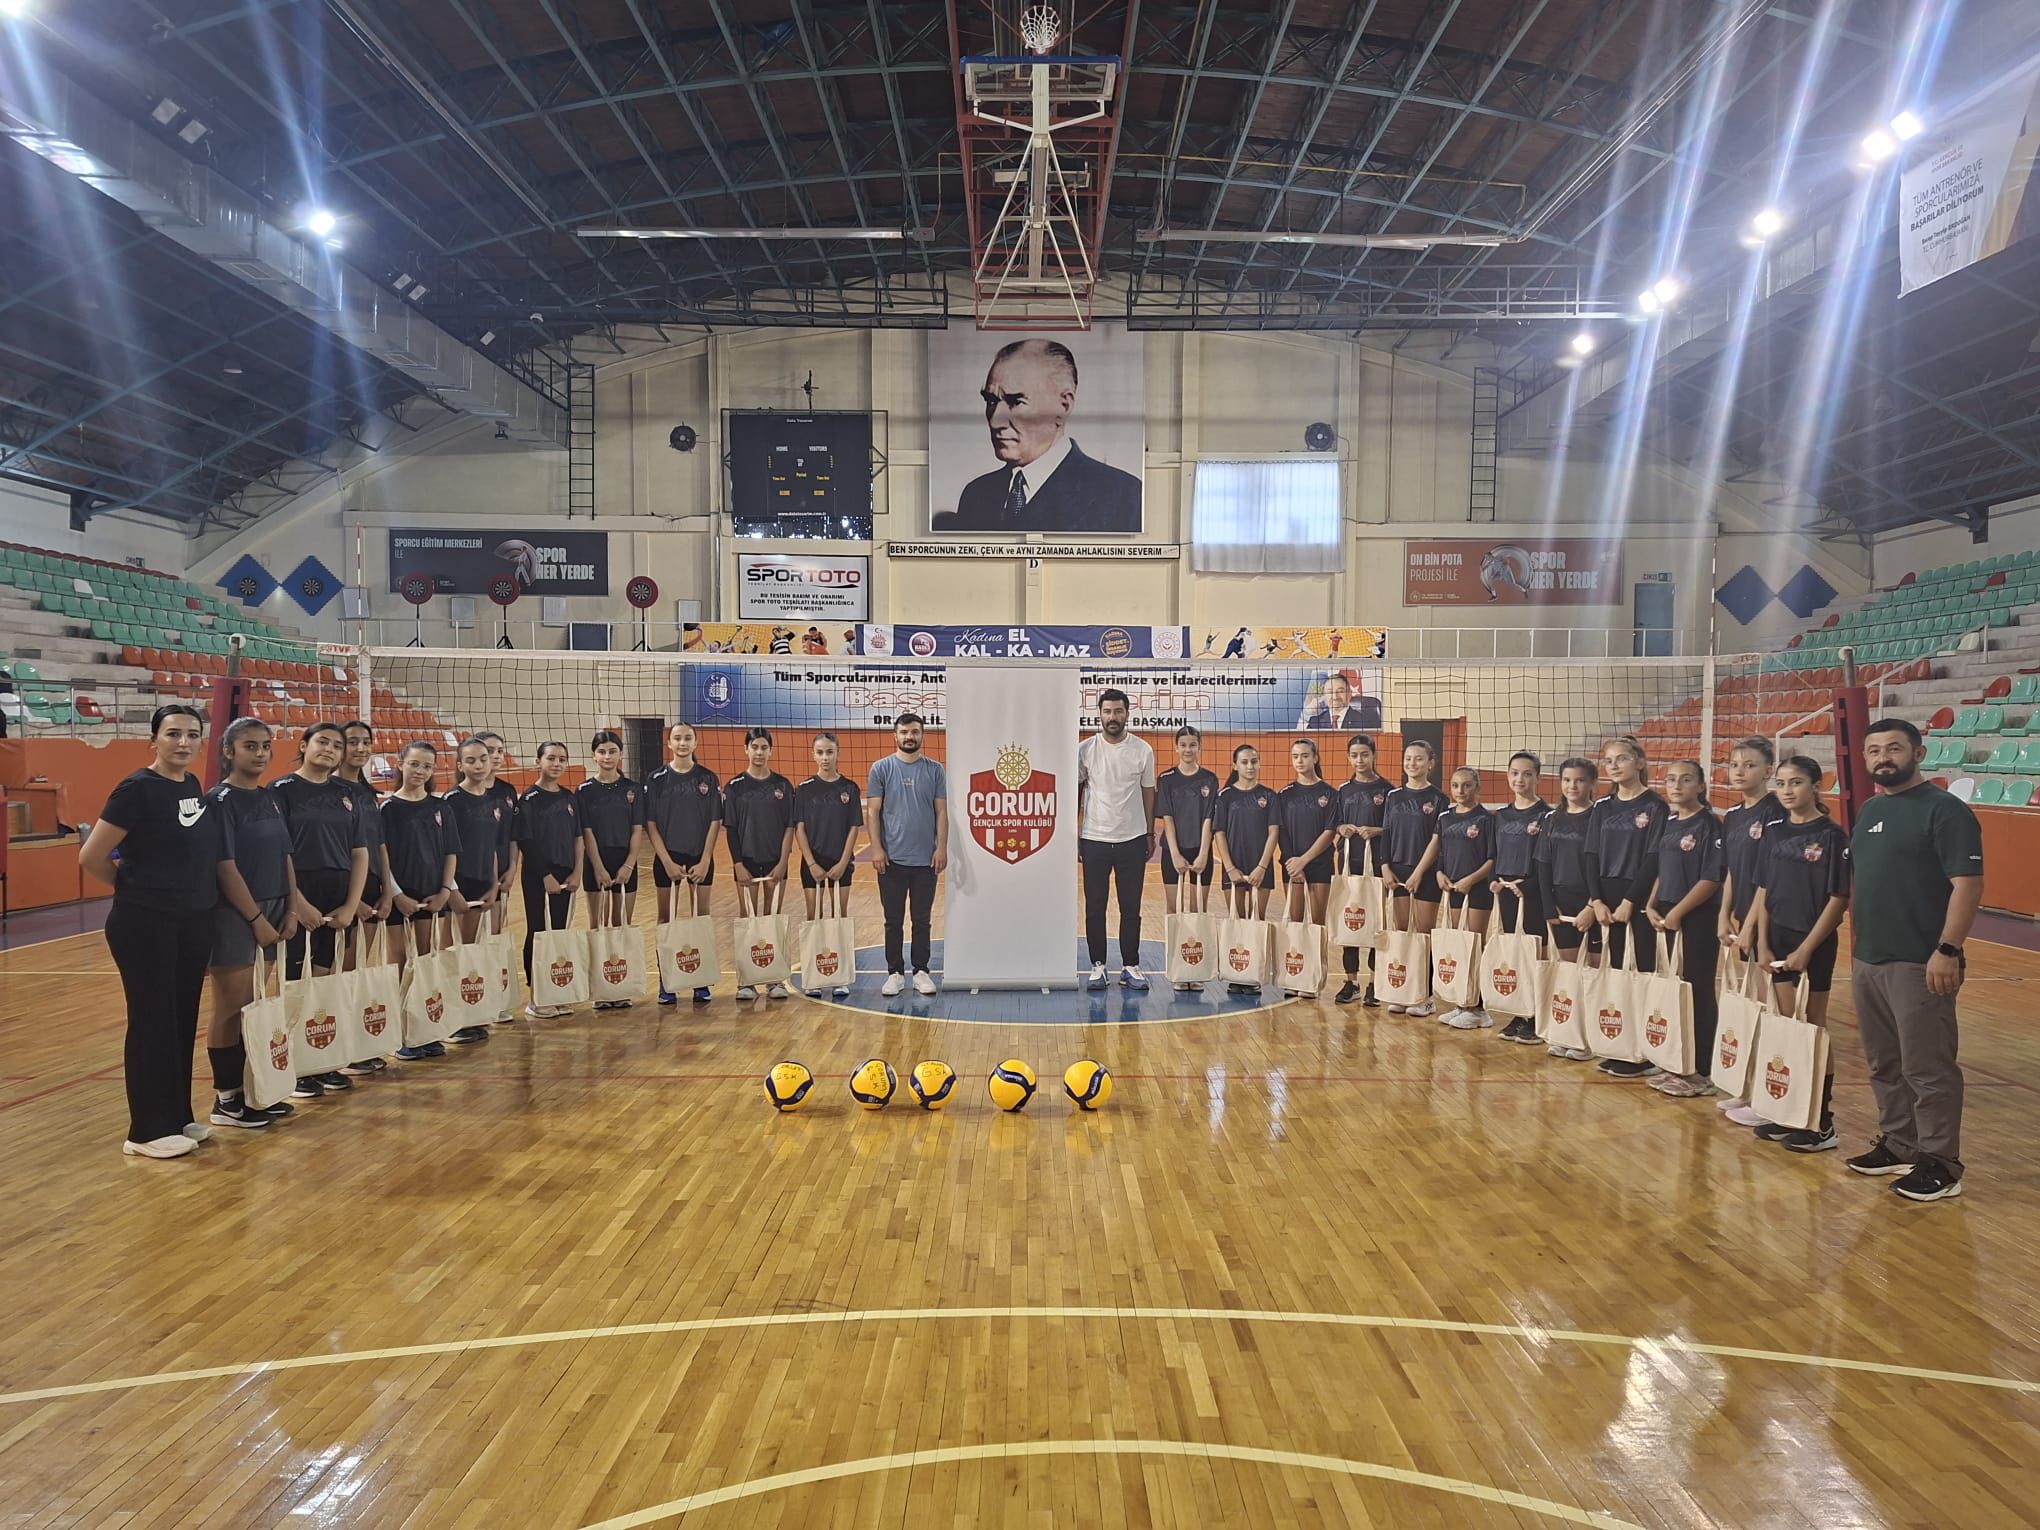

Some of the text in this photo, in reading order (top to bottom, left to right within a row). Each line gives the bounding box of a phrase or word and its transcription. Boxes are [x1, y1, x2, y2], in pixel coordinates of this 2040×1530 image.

[1973, 158, 1984, 172] VE
[1910, 185, 1984, 232] BAŞARILAR DİLİYORUM
[536, 547, 566, 562] SPOR
[890, 545, 906, 554] BEN
[908, 546, 956, 554] SPORCUNUN
[1016, 547, 1034, 555] AYNI
[1036, 547, 1074, 555] ZAMANDA
[1076, 547, 1126, 556] AHLAKLISINI
[1410, 552, 1462, 566] ON BİN POTA
[1530, 551, 1566, 569] SPOR
[560, 564, 594, 580] YERDE
[1557, 571, 1599, 589] YERDE
[954, 628, 1030, 644] Kadına EL
[955, 644, 991, 657] KAL
[1008, 644, 1033, 657] KA
[1050, 645, 1091, 658] MAZ
[774, 671, 802, 682] Tüm
[806, 672, 916, 685] Sporcularımıza,
[1080, 672, 1277, 686] mlerimize ve İdarecilerimize
[970, 792, 1055, 818] ÇORUM
[1003, 819, 1021, 827] SPOR
[1024, 818, 1052, 827] KULÜBÜ
